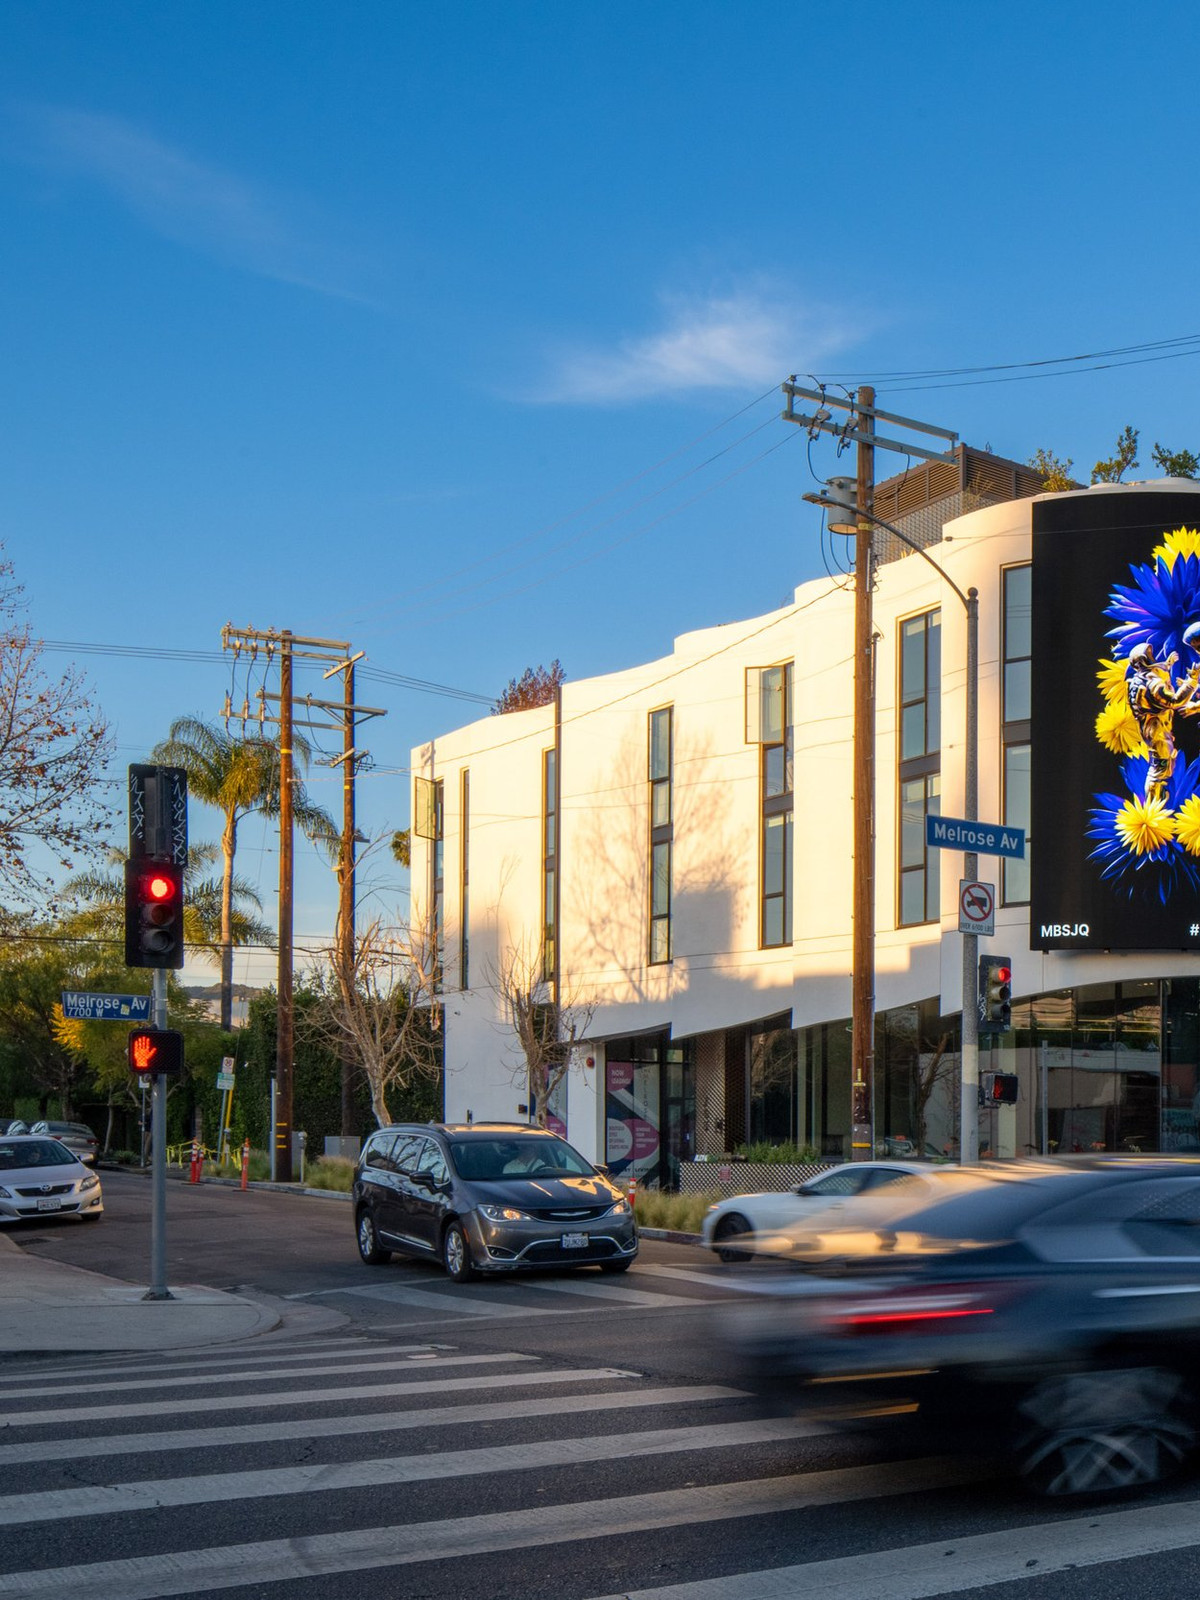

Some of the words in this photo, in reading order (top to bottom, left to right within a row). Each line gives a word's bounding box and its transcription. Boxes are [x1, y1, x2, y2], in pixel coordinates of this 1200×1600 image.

[934, 822, 995, 846] Melrose
[1000, 833, 1018, 849] Av
[1041, 923, 1089, 937] MBSJQ
[67, 993, 120, 1009] Melrose
[131, 997, 147, 1010] Av
[67, 1007, 92, 1017] 7700
[95, 1008, 104, 1017] W
